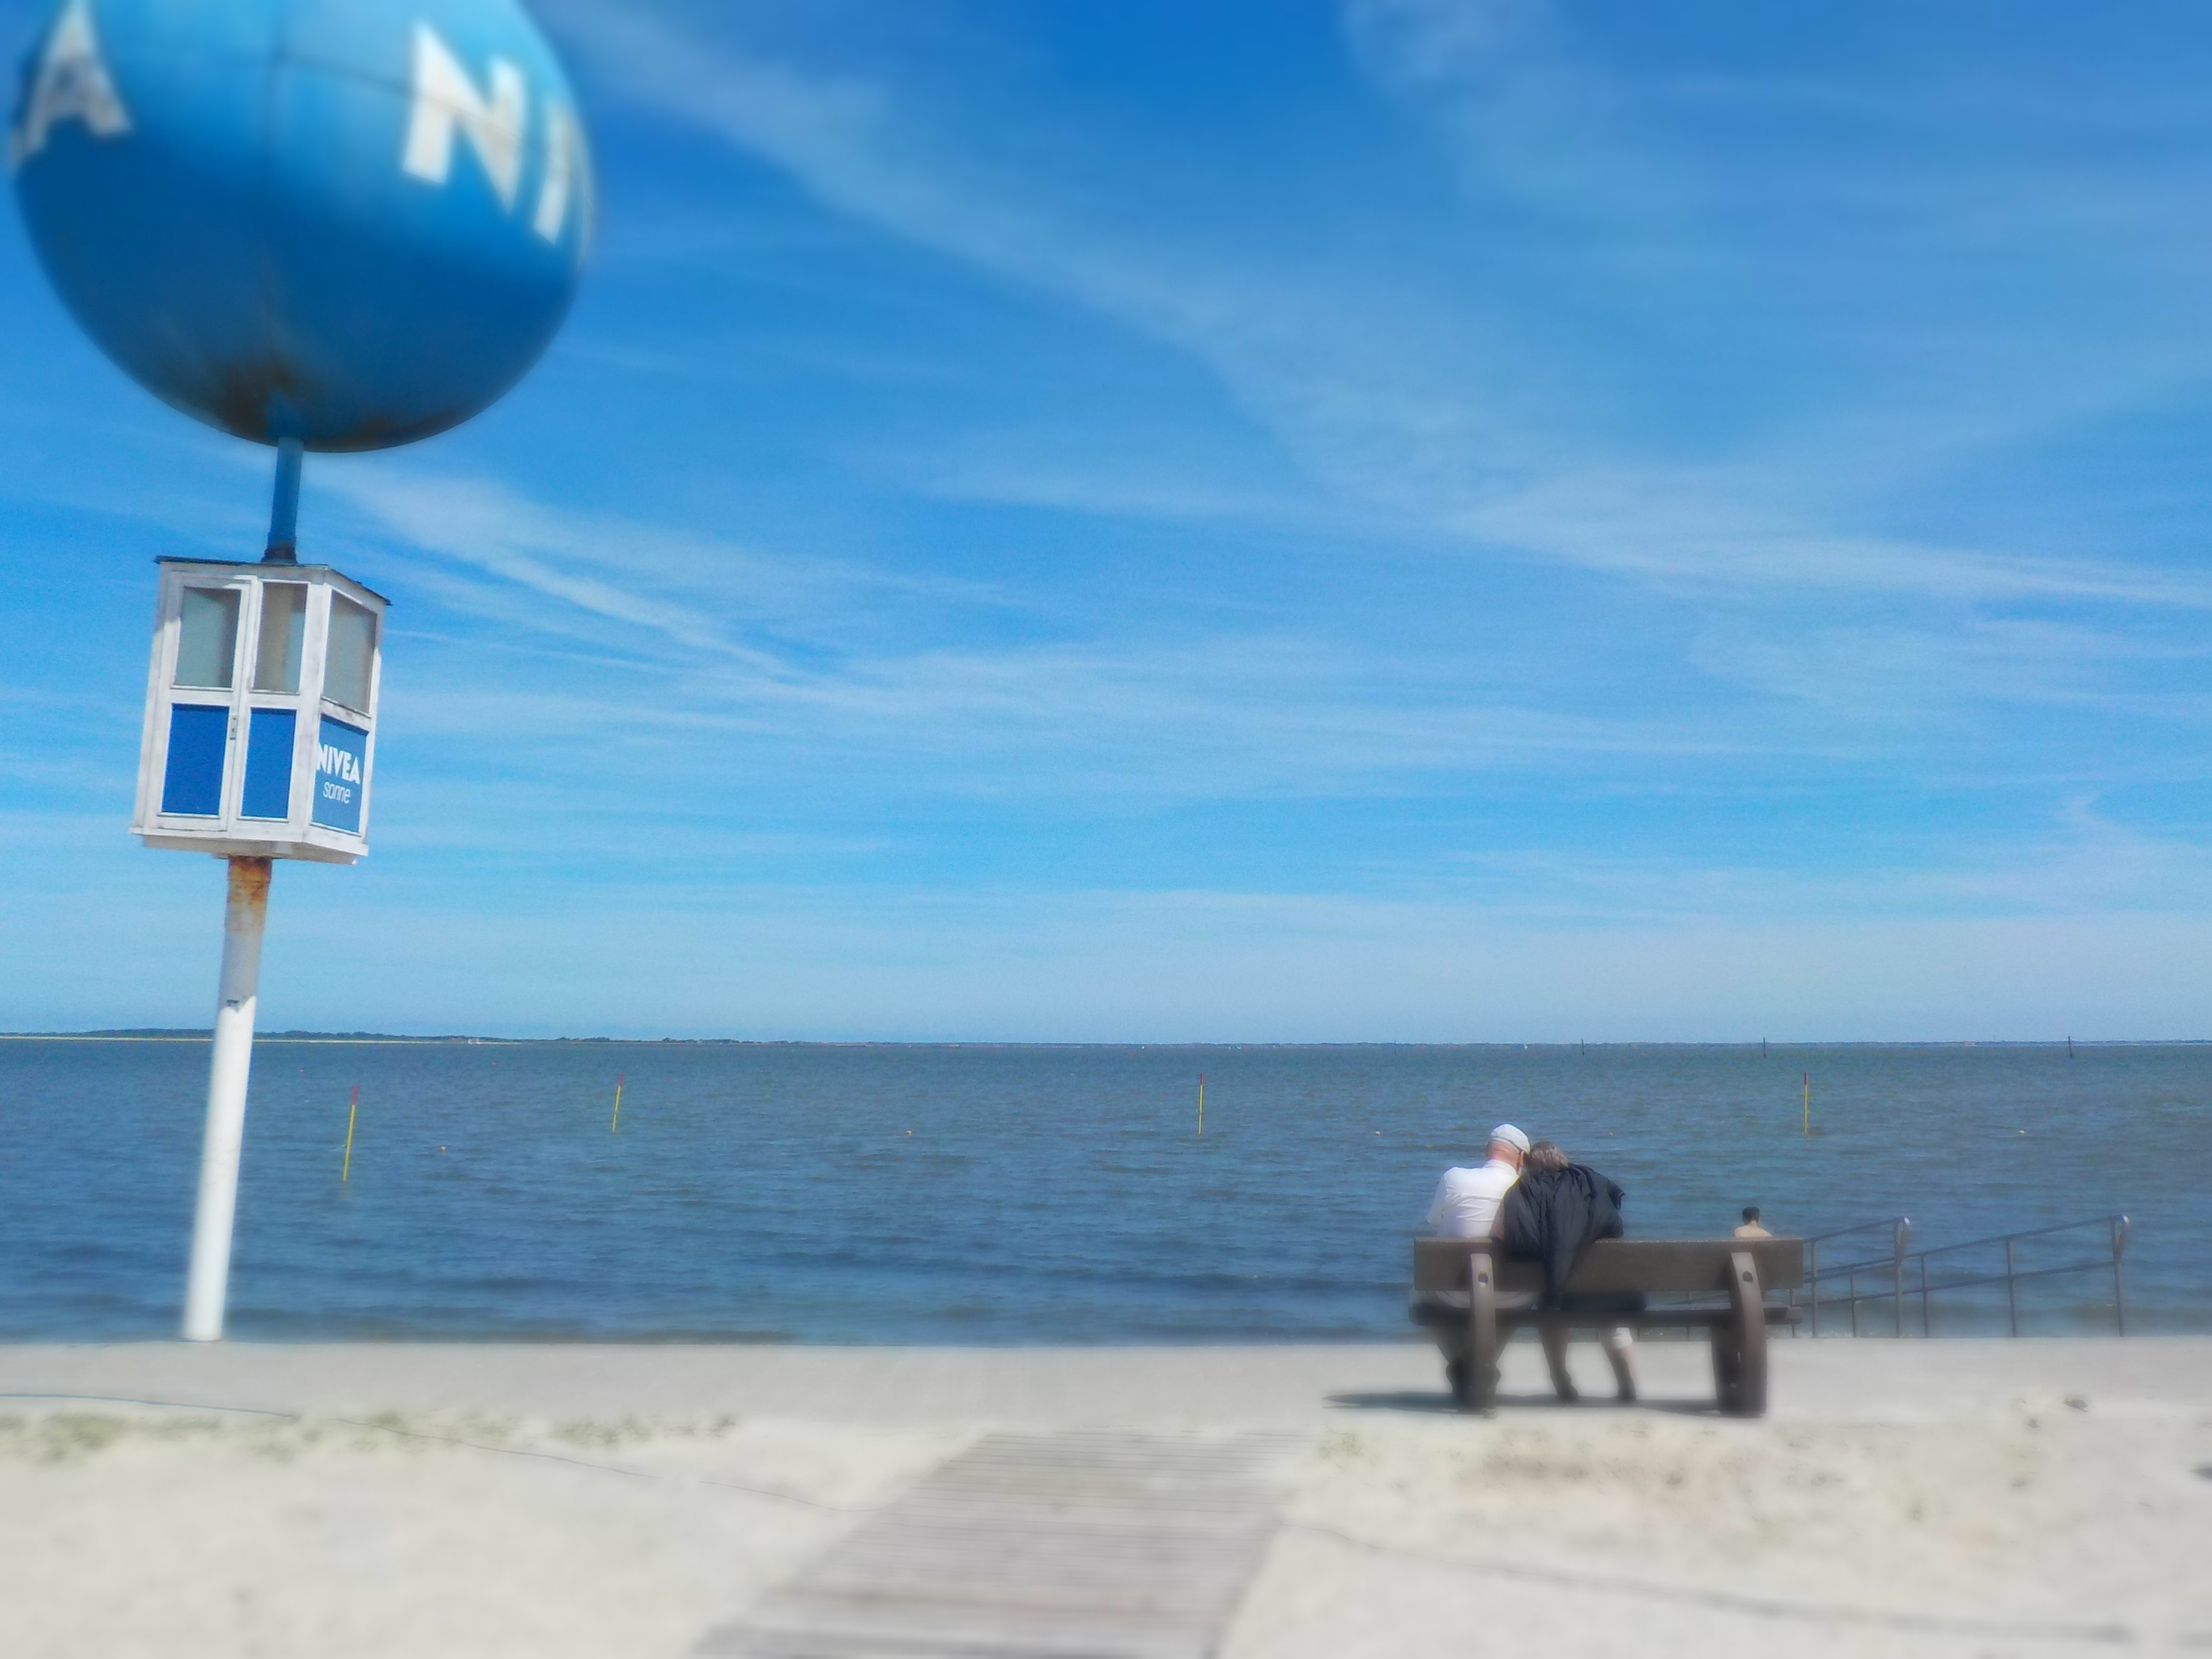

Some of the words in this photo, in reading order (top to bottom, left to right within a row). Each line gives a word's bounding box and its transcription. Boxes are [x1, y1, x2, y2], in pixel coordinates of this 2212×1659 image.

[9, 0, 133, 177] A
[403, 20, 592, 267] NI
[316, 742, 360, 785] NIVEA
[323, 781, 351, 804] sonne
